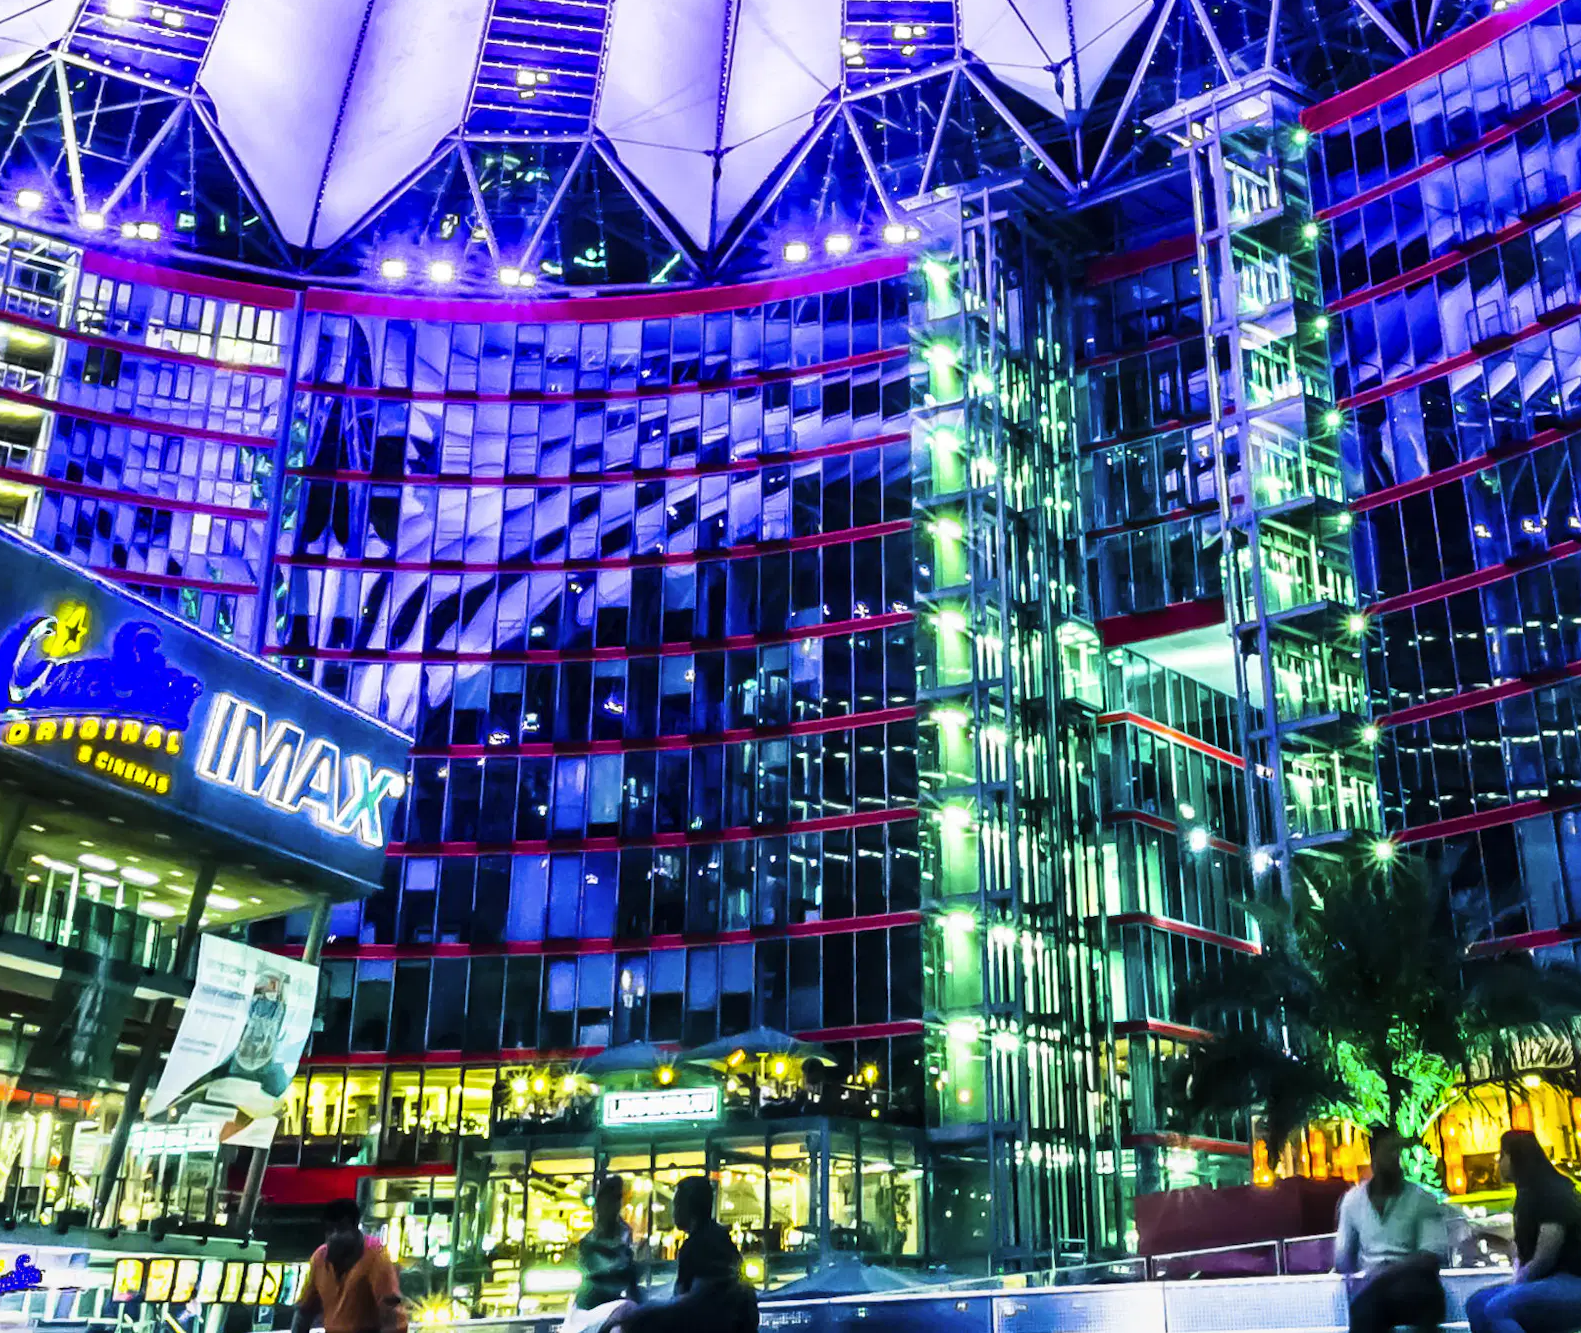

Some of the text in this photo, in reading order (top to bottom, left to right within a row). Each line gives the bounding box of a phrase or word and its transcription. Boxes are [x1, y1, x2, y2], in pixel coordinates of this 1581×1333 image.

[6, 717, 180, 755] ORIGINAL
[95, 751, 169, 794] CINEMAS
[197, 692, 396, 847] IMAX
[257, 1305, 270, 1323] P
